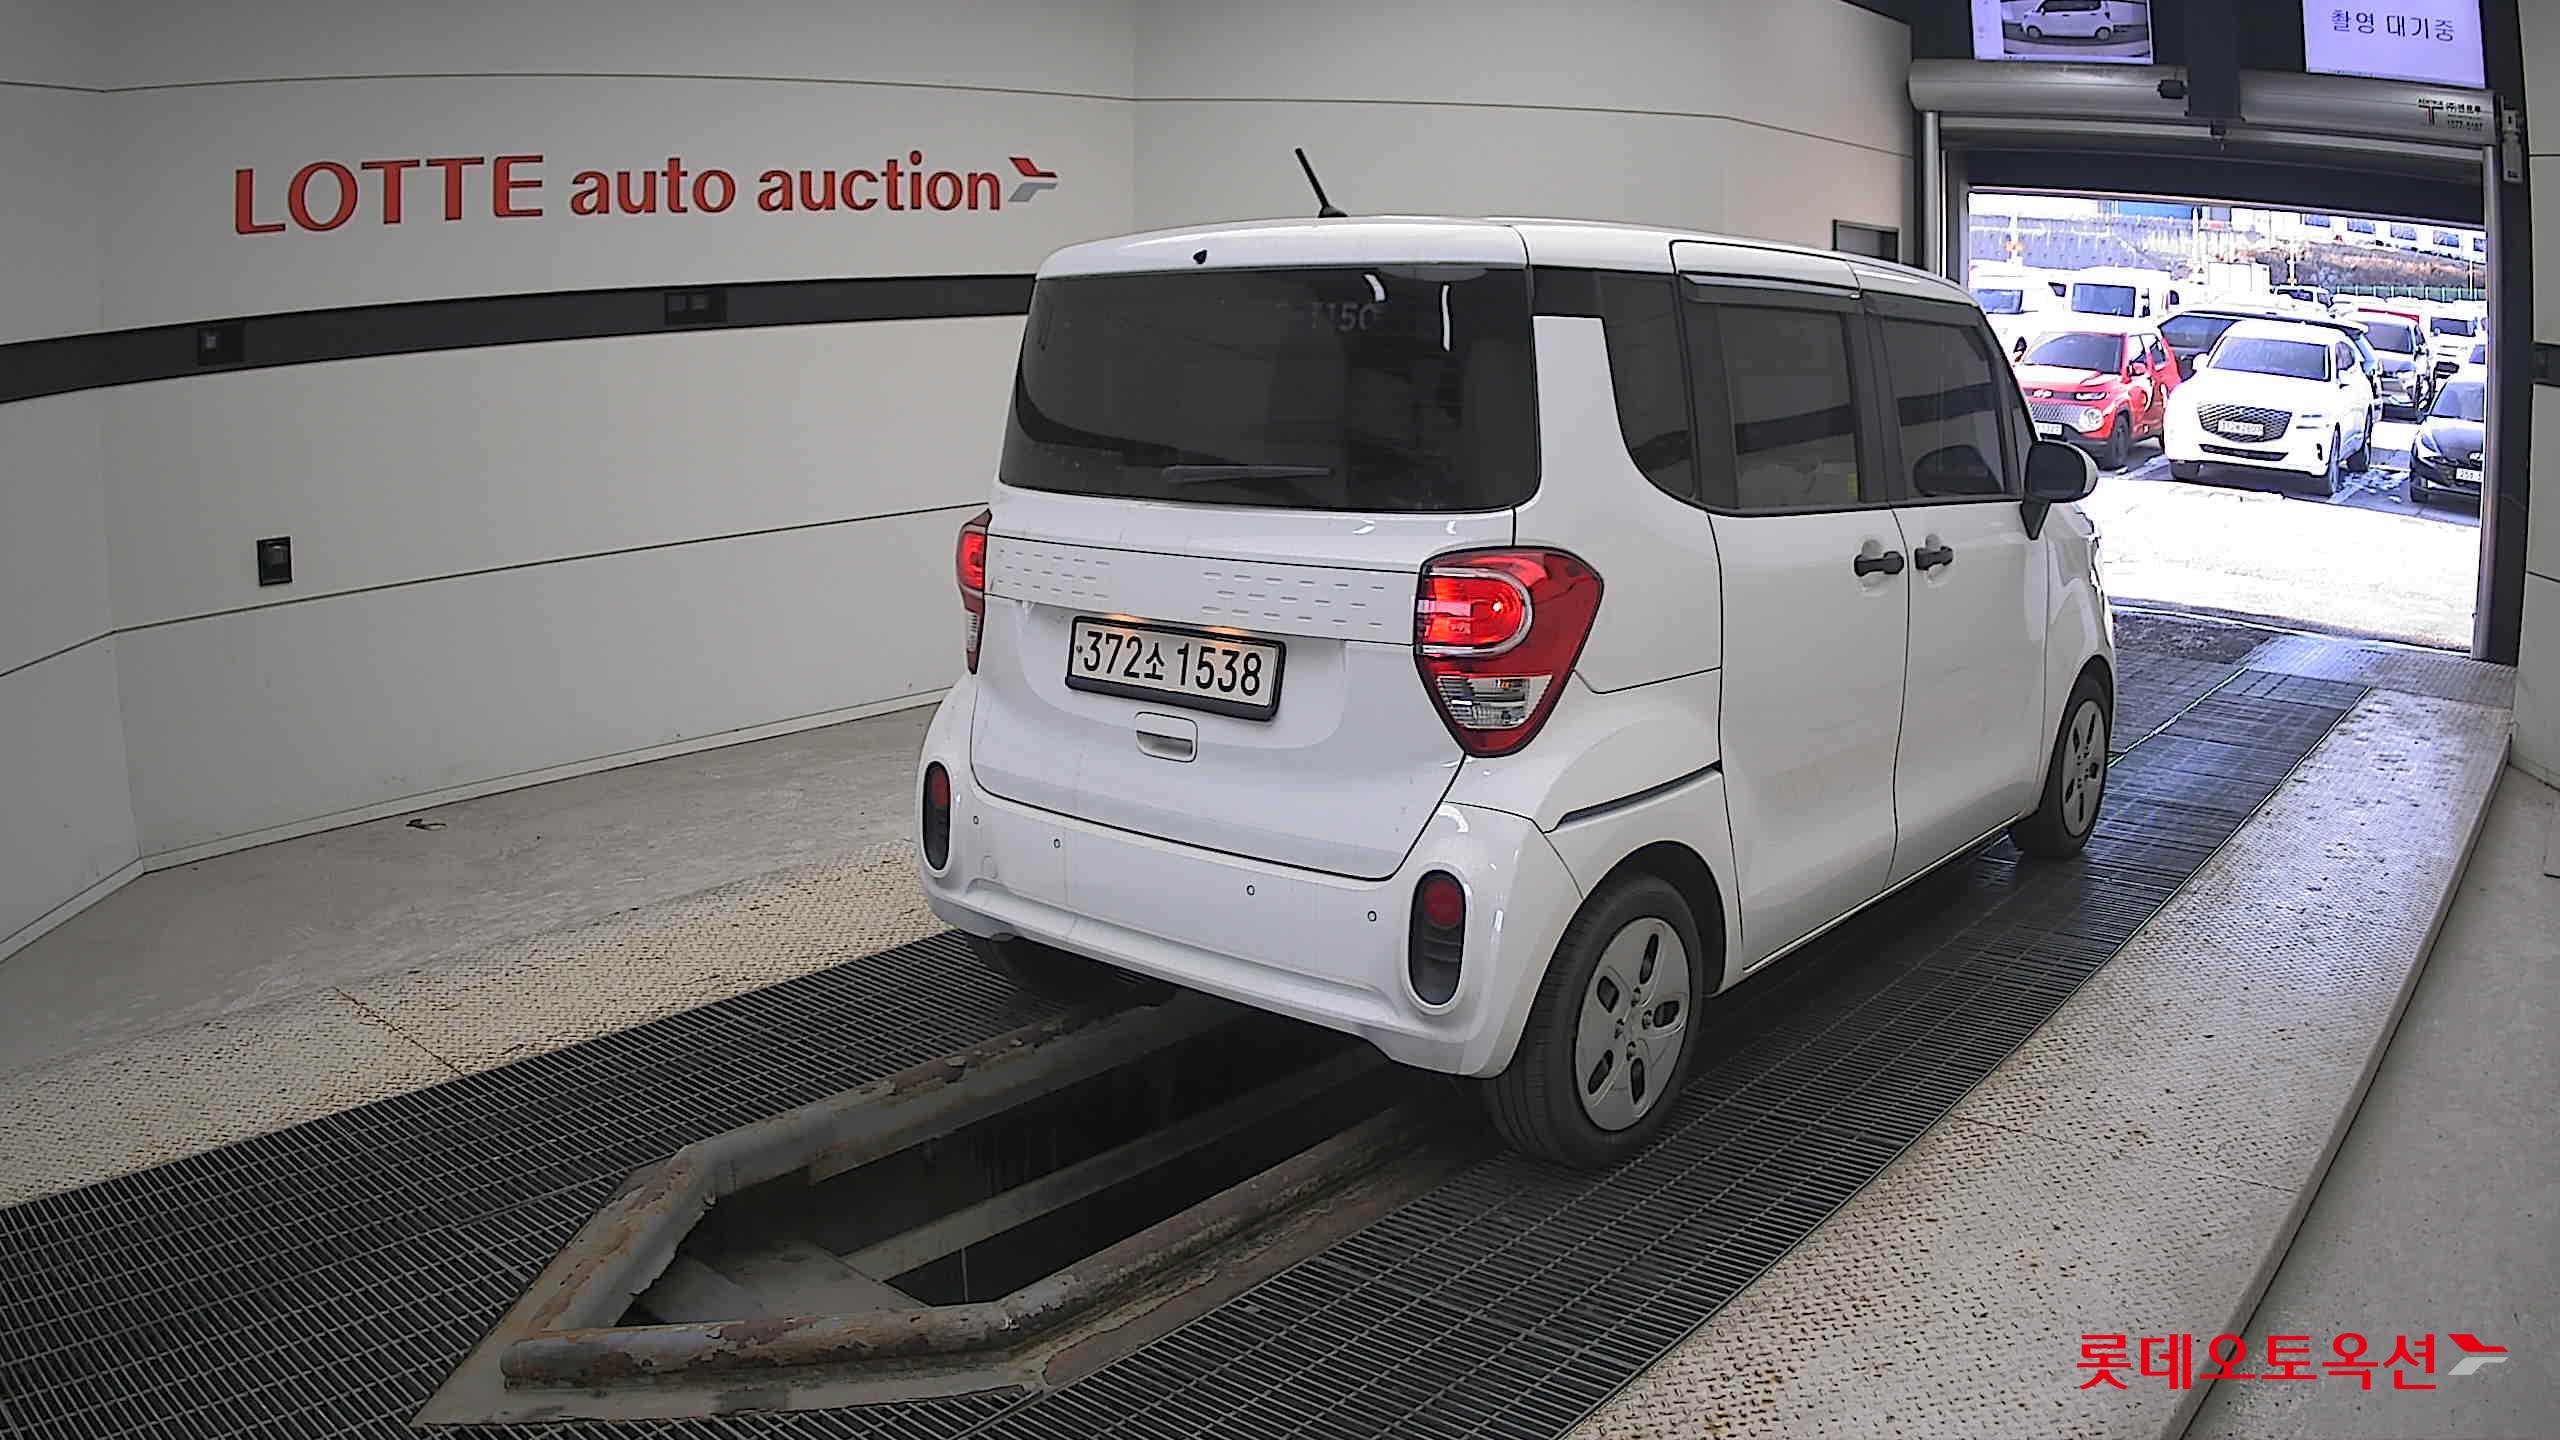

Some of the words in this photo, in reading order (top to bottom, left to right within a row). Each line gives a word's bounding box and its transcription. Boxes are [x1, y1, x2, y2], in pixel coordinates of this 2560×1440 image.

[2331, 9, 2375, 35] 촬영
[2386, 15, 2454, 42] 대기중
[234, 154, 544, 235] LOTTE
[570, 155, 737, 216] auto
[758, 149, 1002, 211] auction
[1083, 630, 1165, 681] 372소
[1177, 642, 1262, 697] 1538
